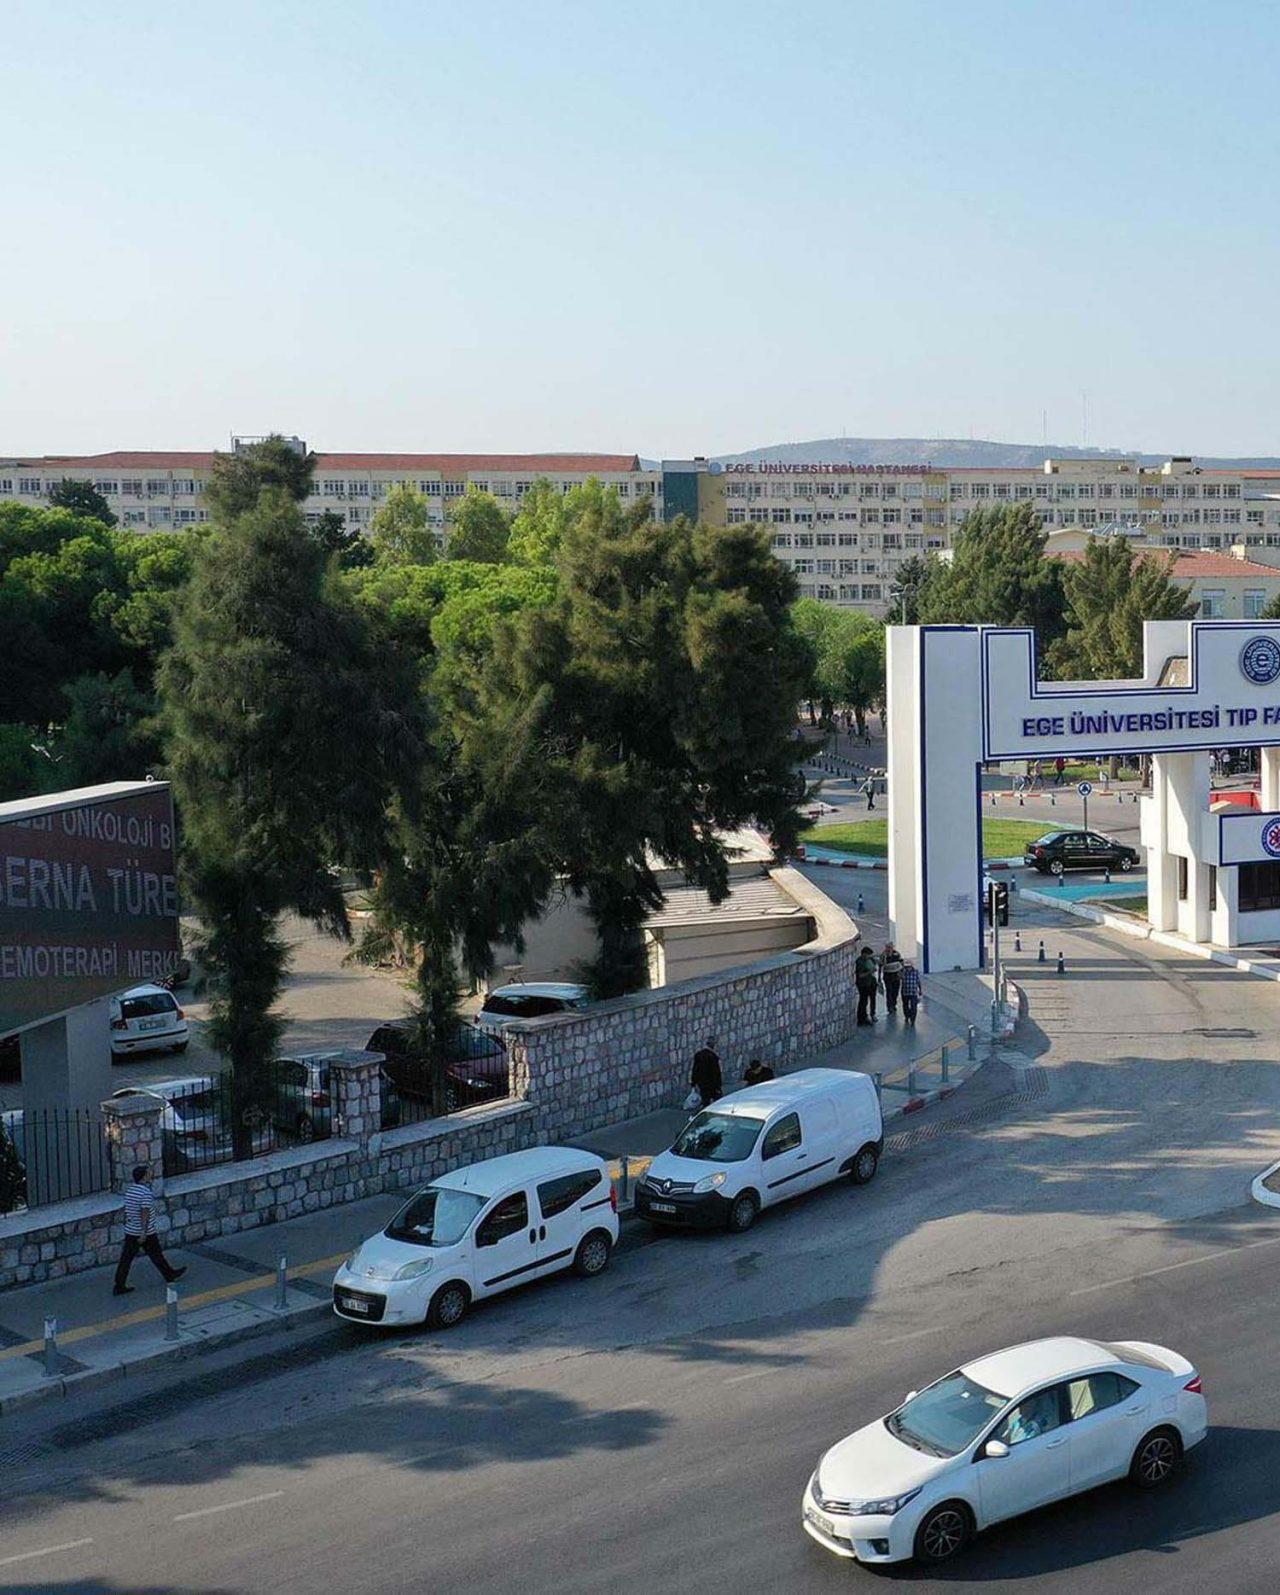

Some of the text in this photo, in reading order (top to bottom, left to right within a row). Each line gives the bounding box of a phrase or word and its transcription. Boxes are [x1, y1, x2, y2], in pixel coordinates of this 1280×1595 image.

[725, 463, 753, 474] EGE
[759, 460, 854, 474] ÜNİVERSİTESİ
[1022, 718, 1064, 737] EGE
[1070, 705, 1220, 735] ÜNİVERSİTESİ
[1226, 708, 1258, 727] TIP
[62, 808, 153, 847] ONKOLOJİ
[0, 856, 97, 912] ERNA
[0, 942, 117, 978] EMOTERAPİ
